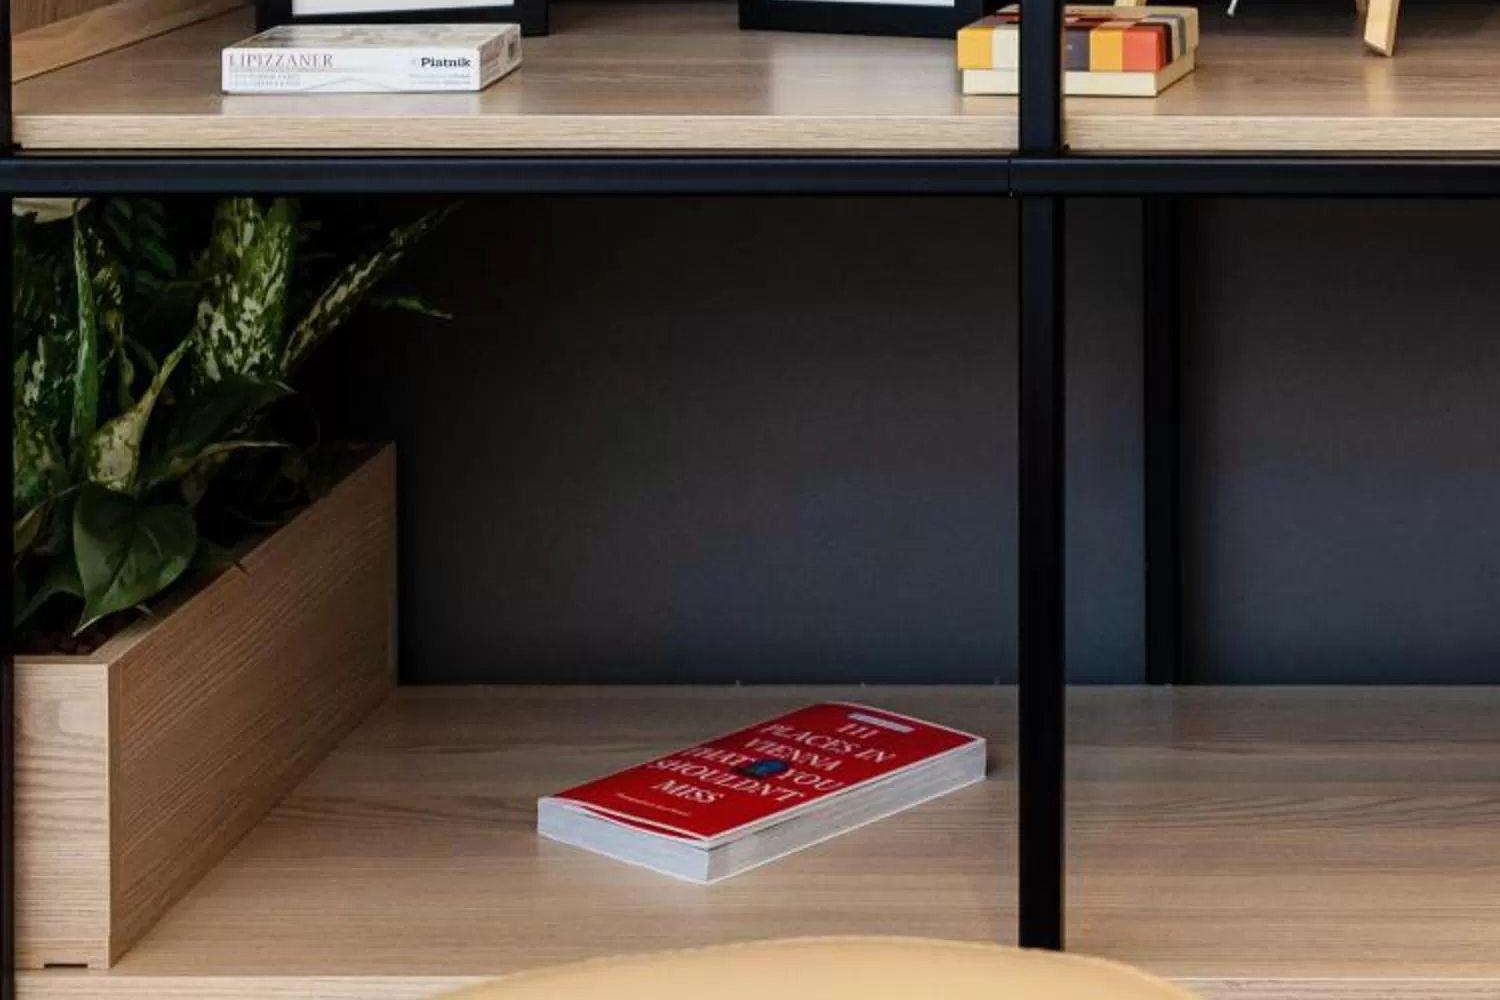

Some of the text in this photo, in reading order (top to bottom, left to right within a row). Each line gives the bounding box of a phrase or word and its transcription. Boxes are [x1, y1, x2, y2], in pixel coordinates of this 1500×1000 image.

[228, 52, 334, 68] LIPIZZANER
[421, 56, 471, 68] Piatnik
[743, 737, 844, 771] VIENNA
[760, 723, 860, 754] PLACES
[853, 747, 897, 763] IN
[651, 779, 725, 803] MISS
[776, 768, 846, 792] YOU
